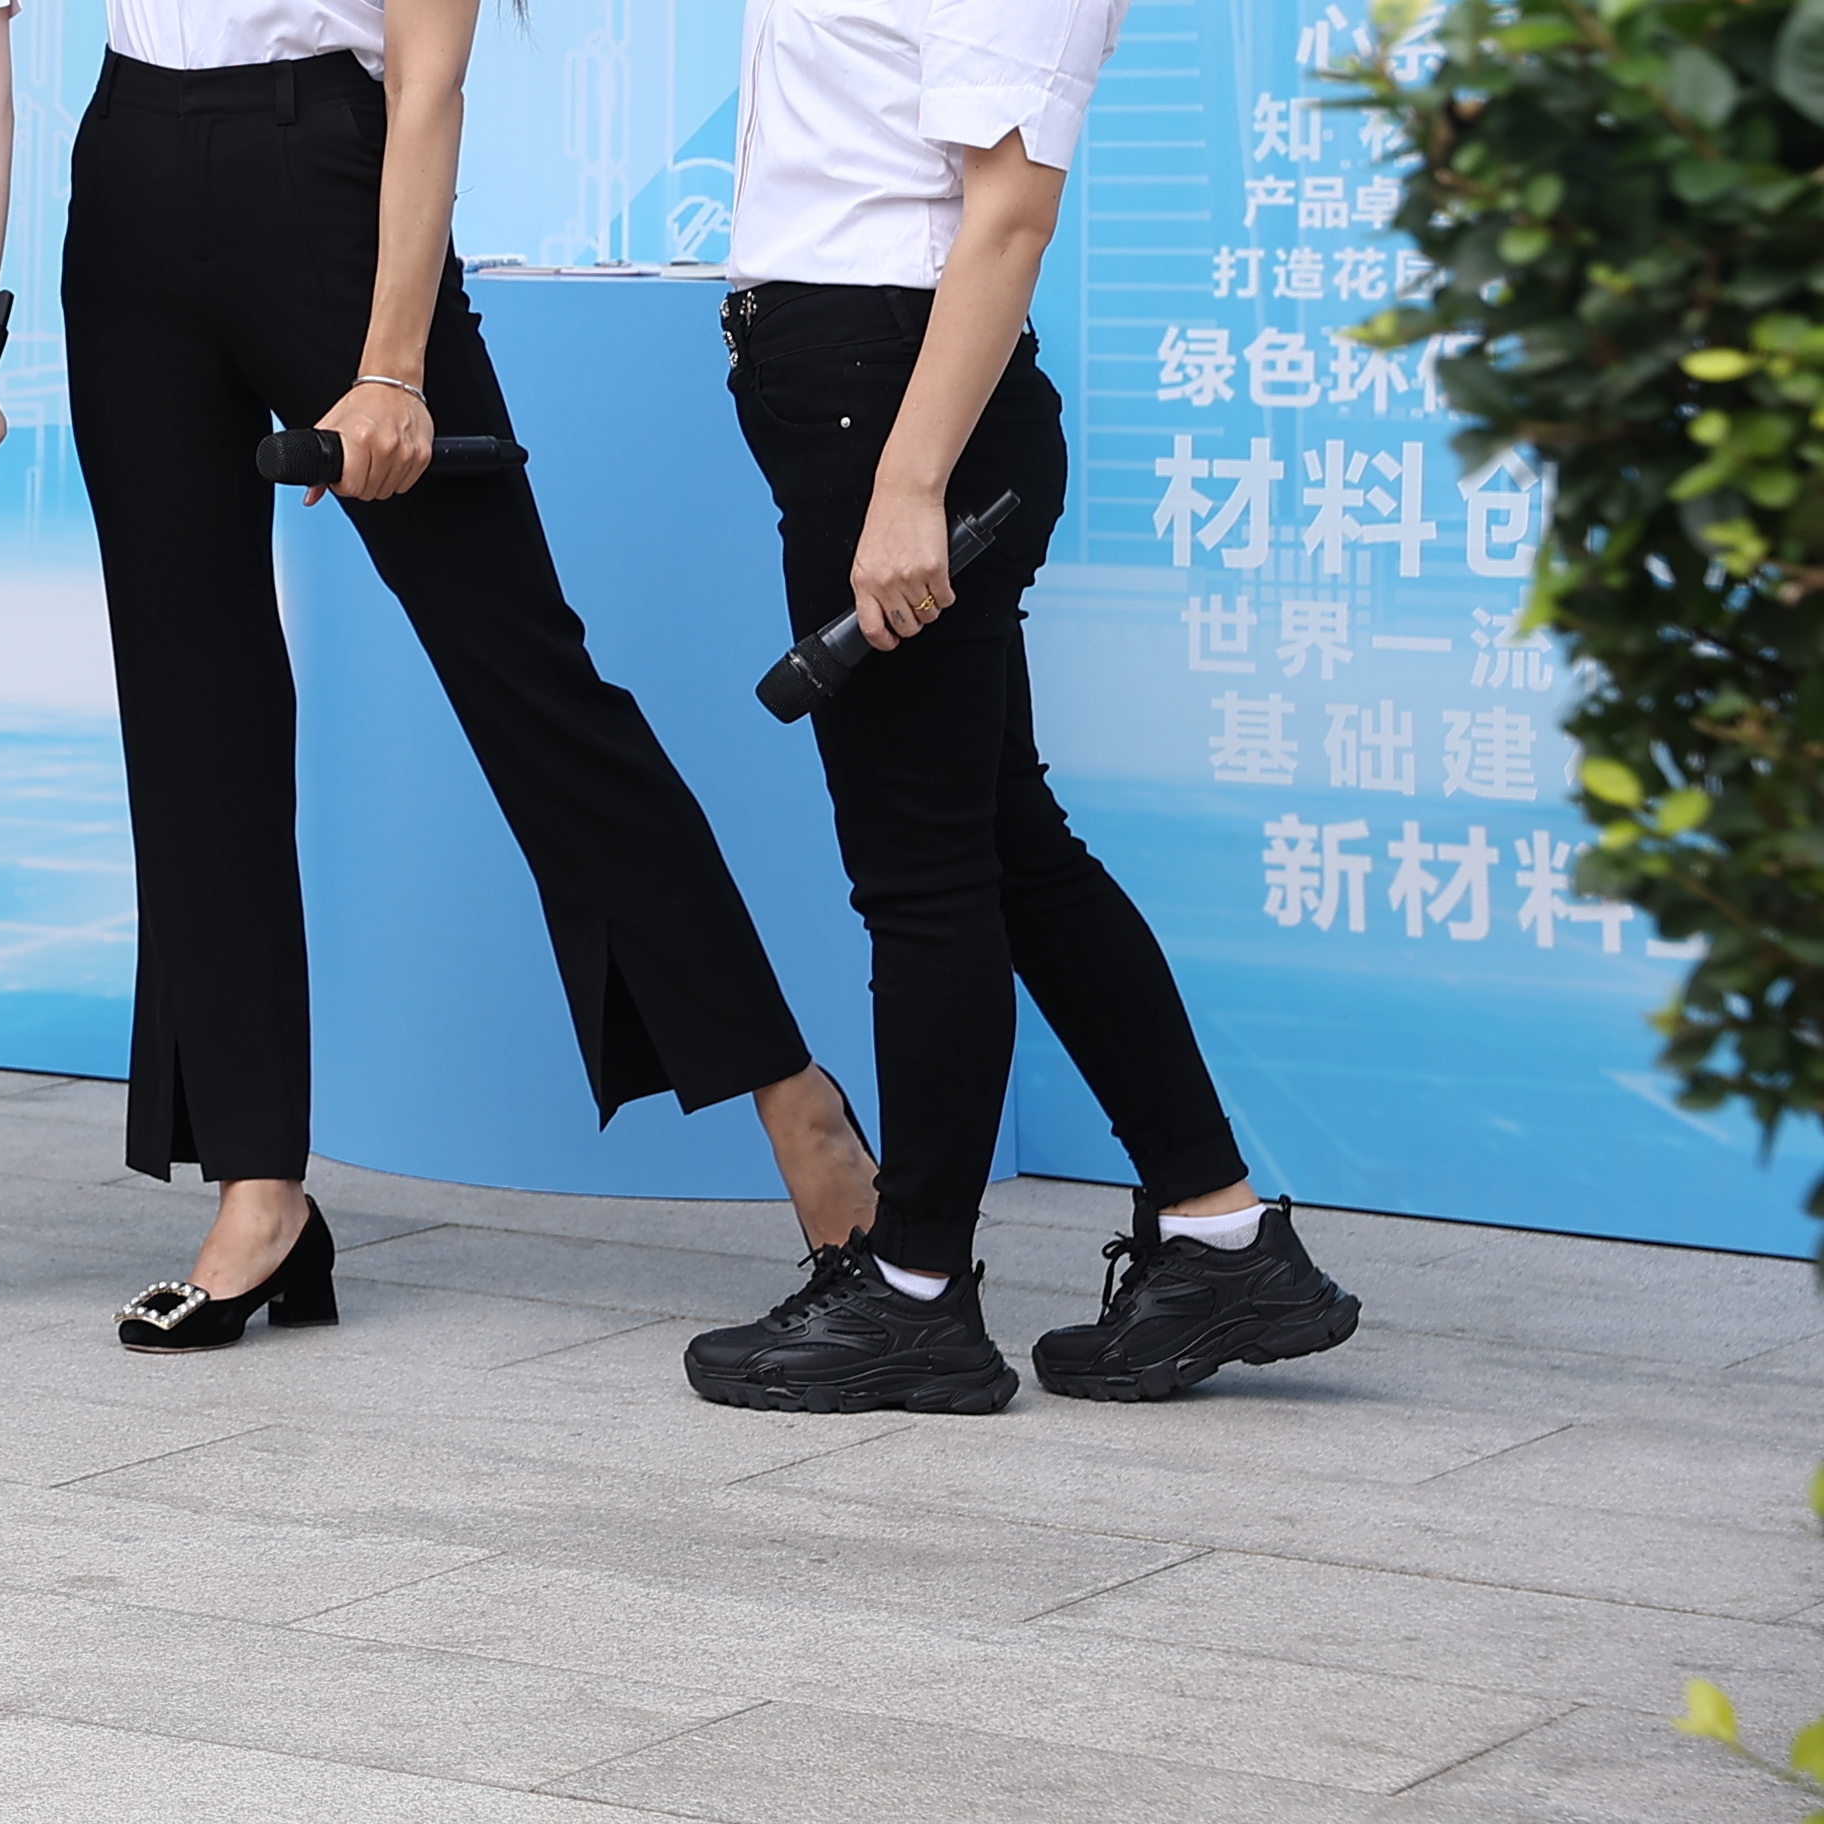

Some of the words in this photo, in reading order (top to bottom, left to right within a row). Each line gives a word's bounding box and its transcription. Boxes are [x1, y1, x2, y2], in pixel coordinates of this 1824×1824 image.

[1296, 4, 1520, 82] 心系
[1243, 175, 1467, 230] 产品卓
[1212, 245, 1492, 302] 打造花园
[1180, 594, 1582, 693] 世界一流
[1208, 691, 1582, 803] 基础建
[1261, 812, 1692, 960] 新材料
